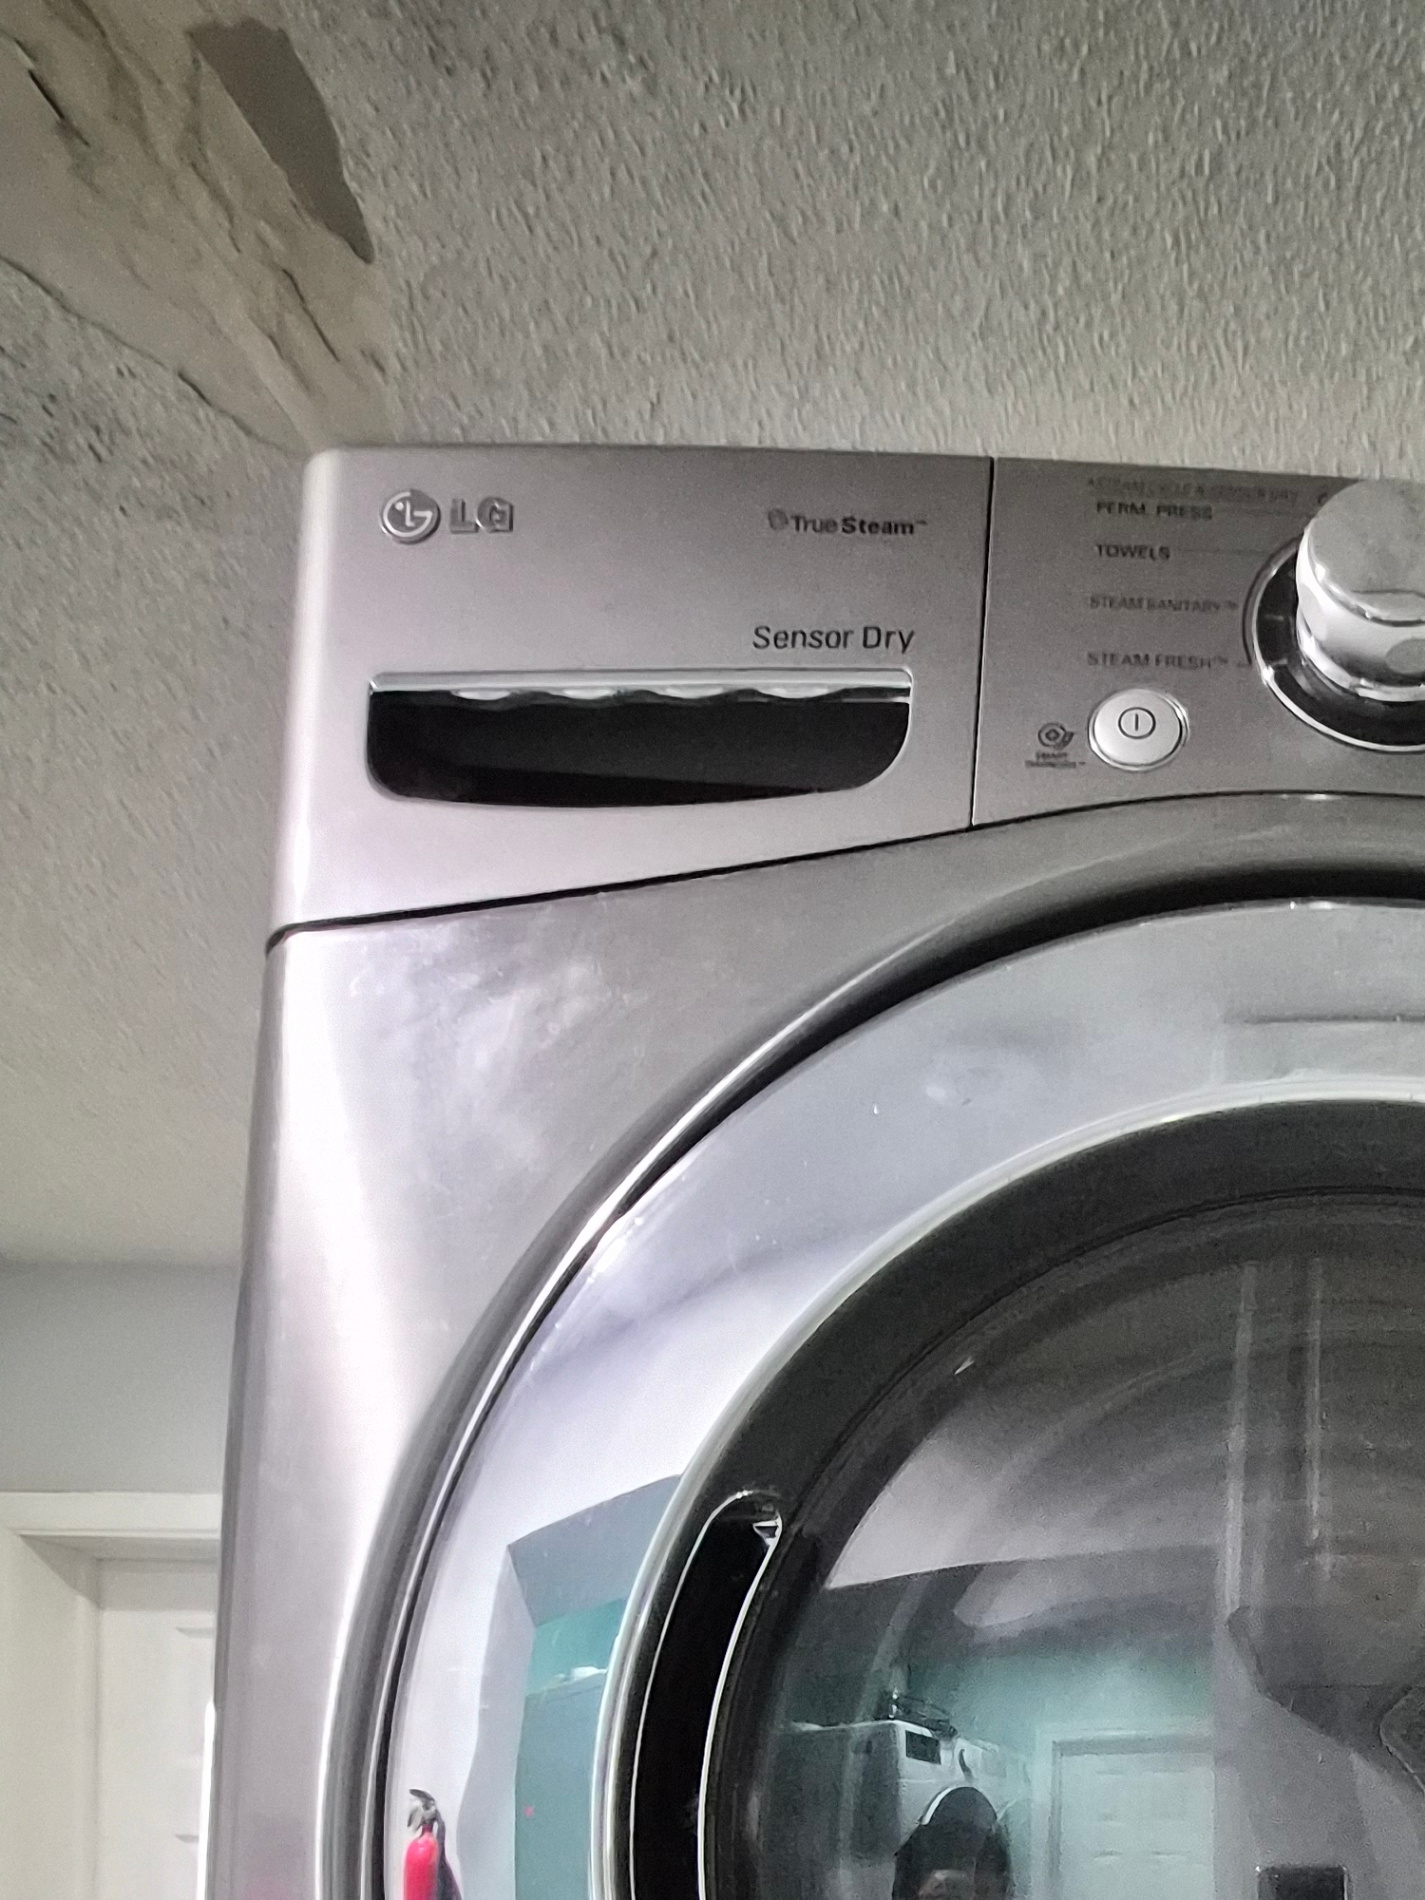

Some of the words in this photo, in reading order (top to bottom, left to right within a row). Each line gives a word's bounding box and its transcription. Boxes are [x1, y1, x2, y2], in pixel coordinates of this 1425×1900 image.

[1156, 503, 1212, 521] PRESS
[1095, 544, 1171, 561] TOWELS
[753, 625, 855, 649] Sensor
[862, 626, 914, 654] Dry
[1086, 651, 1150, 667] STEAM
